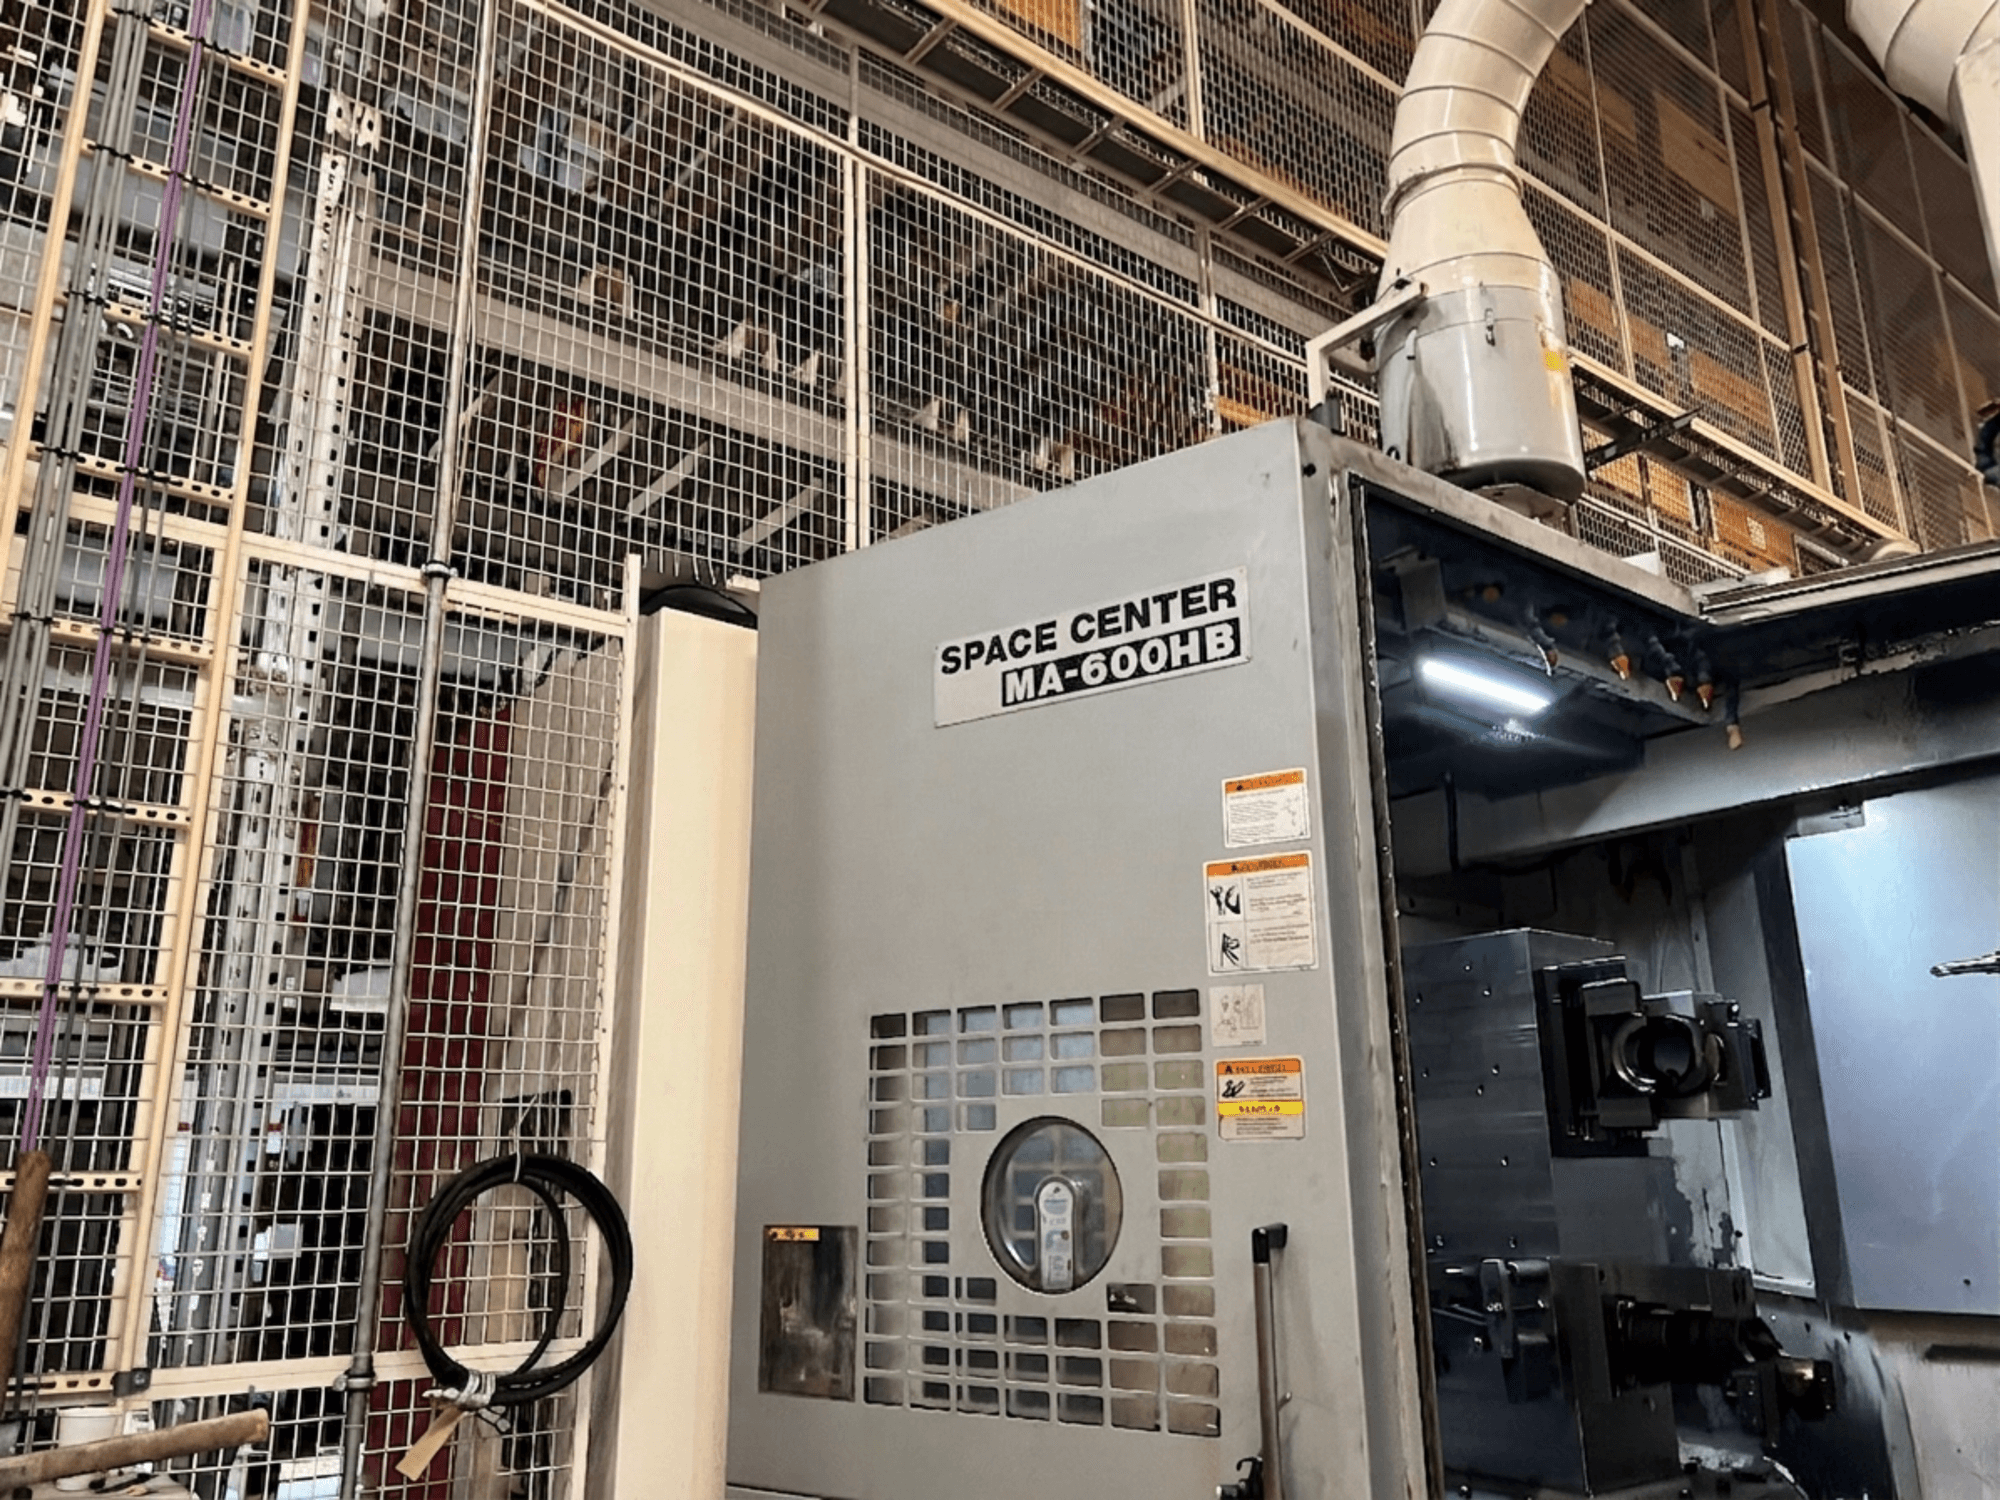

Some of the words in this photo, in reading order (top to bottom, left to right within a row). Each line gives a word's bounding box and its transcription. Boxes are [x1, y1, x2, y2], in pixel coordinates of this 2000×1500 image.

[941, 620, 1058, 675] SPACE
[1070, 577, 1237, 644] CENTER
[1004, 621, 1237, 705] MA-600HB
